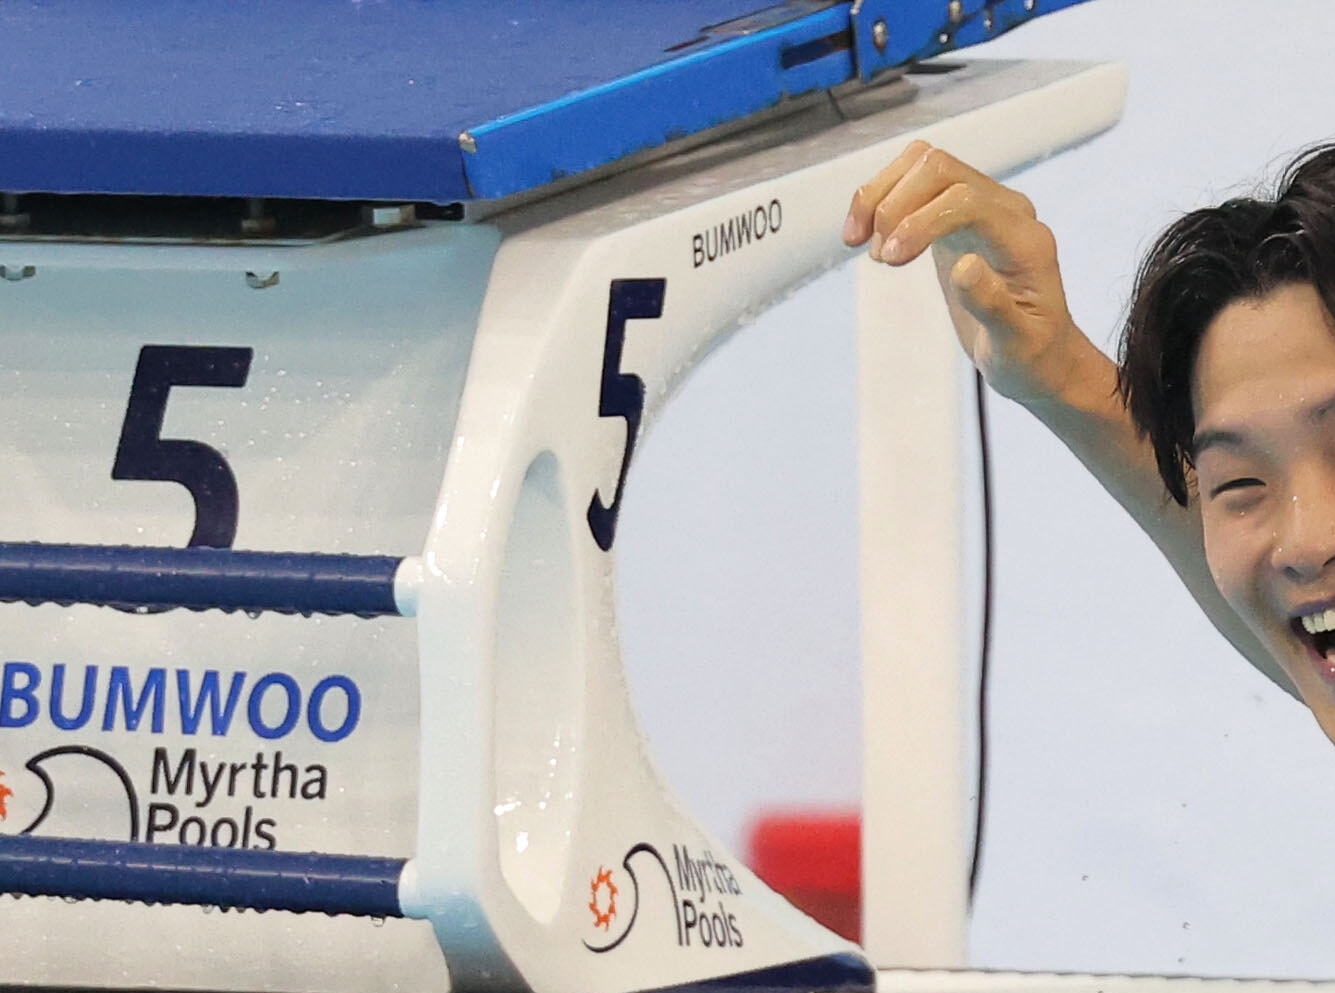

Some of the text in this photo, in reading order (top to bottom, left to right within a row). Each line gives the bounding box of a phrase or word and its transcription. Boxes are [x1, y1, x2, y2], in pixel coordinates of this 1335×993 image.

[692, 199, 783, 268] BUMWOO
[587, 277, 667, 552] 5
[111, 345, 254, 549] 5
[0, 662, 361, 742] BUMWOO
[150, 747, 328, 807] Myrtha
[146, 802, 278, 851] Pools
[673, 844, 742, 902] Myrtha
[683, 900, 743, 947] Pools
